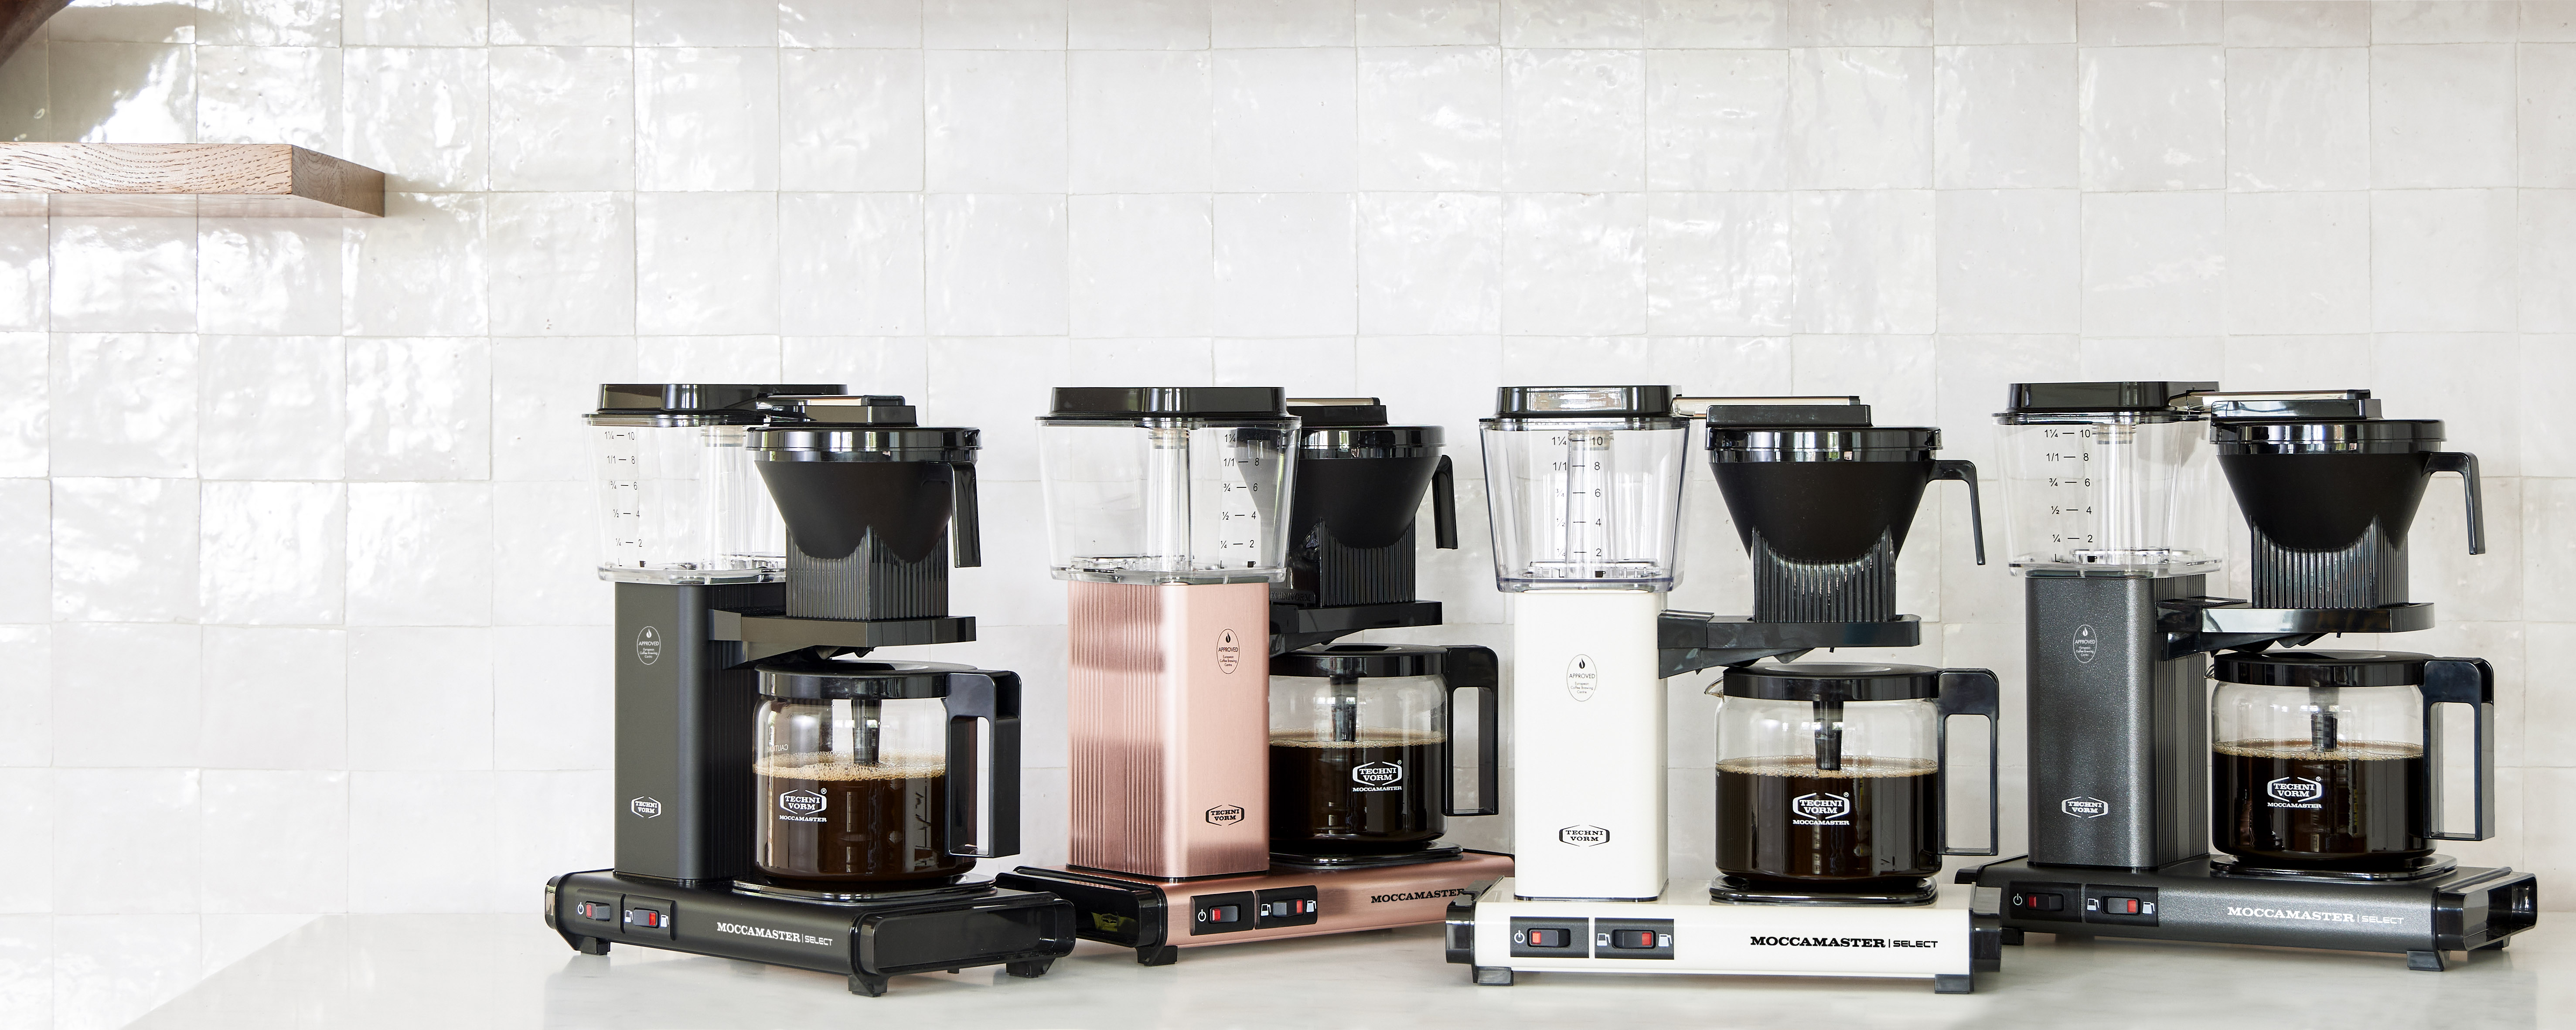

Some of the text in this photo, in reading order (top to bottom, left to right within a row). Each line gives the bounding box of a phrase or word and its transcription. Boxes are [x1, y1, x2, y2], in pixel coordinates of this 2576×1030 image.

[628, 432, 635, 440] 10
[2080, 429, 2090, 438] 10
[1591, 437, 1603, 445] 10
[607, 455, 616, 464] 1/1
[2046, 453, 2089, 462] 1/1 8
[1223, 458, 1259, 466] 1/1 8
[1553, 462, 1600, 471] 1/1 8
[634, 482, 637, 490] 6
[2085, 478, 2090, 486] 6
[1253, 483, 1257, 491] 6
[1595, 489, 1601, 497] 6
[636, 510, 640, 518] 4
[638, 539, 642, 547] 2
[1250, 540, 1254, 548] 2
[618, 558, 622, 566] L
[2055, 554, 2060, 562] L
[1220, 560, 1224, 569] L
[1559, 568, 1564, 578] L
[1269, 591, 1311, 601] ECHNIVORM
[1371, 888, 1465, 903] MOCCAMASTER
[2227, 907, 2404, 924] MOCCAMASTER SELECT
[717, 922, 833, 946] MOCCAMASTER SELECT
[1750, 936, 1885, 948] MOCCAMASTER
